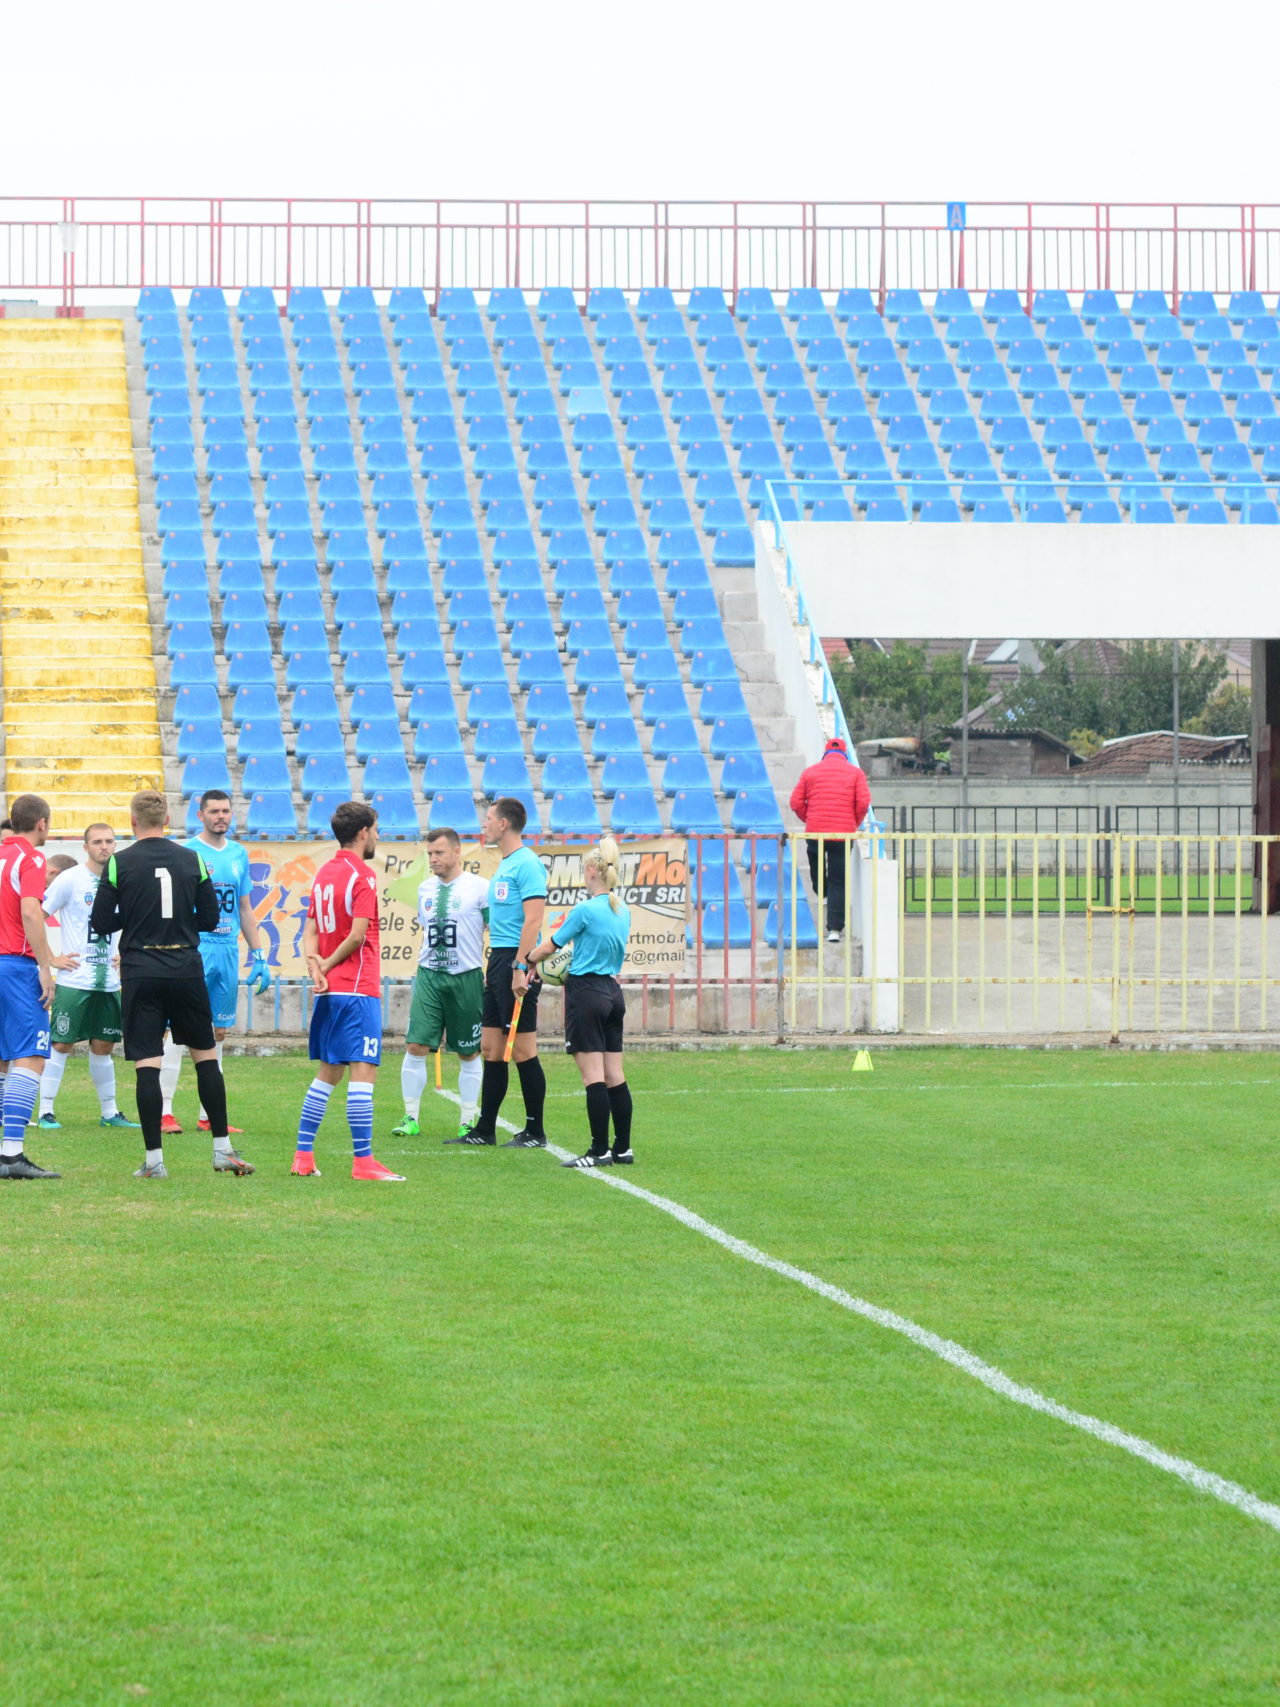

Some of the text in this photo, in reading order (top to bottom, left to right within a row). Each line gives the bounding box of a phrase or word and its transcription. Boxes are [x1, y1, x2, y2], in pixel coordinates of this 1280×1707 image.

[154, 867, 174, 919] 1
[314, 882, 337, 934] 13
[381, 945, 413, 960] aze
[624, 949, 685, 966] z@gmail
[36, 1031, 50, 1051] 24
[363, 1036, 379, 1058] 13
